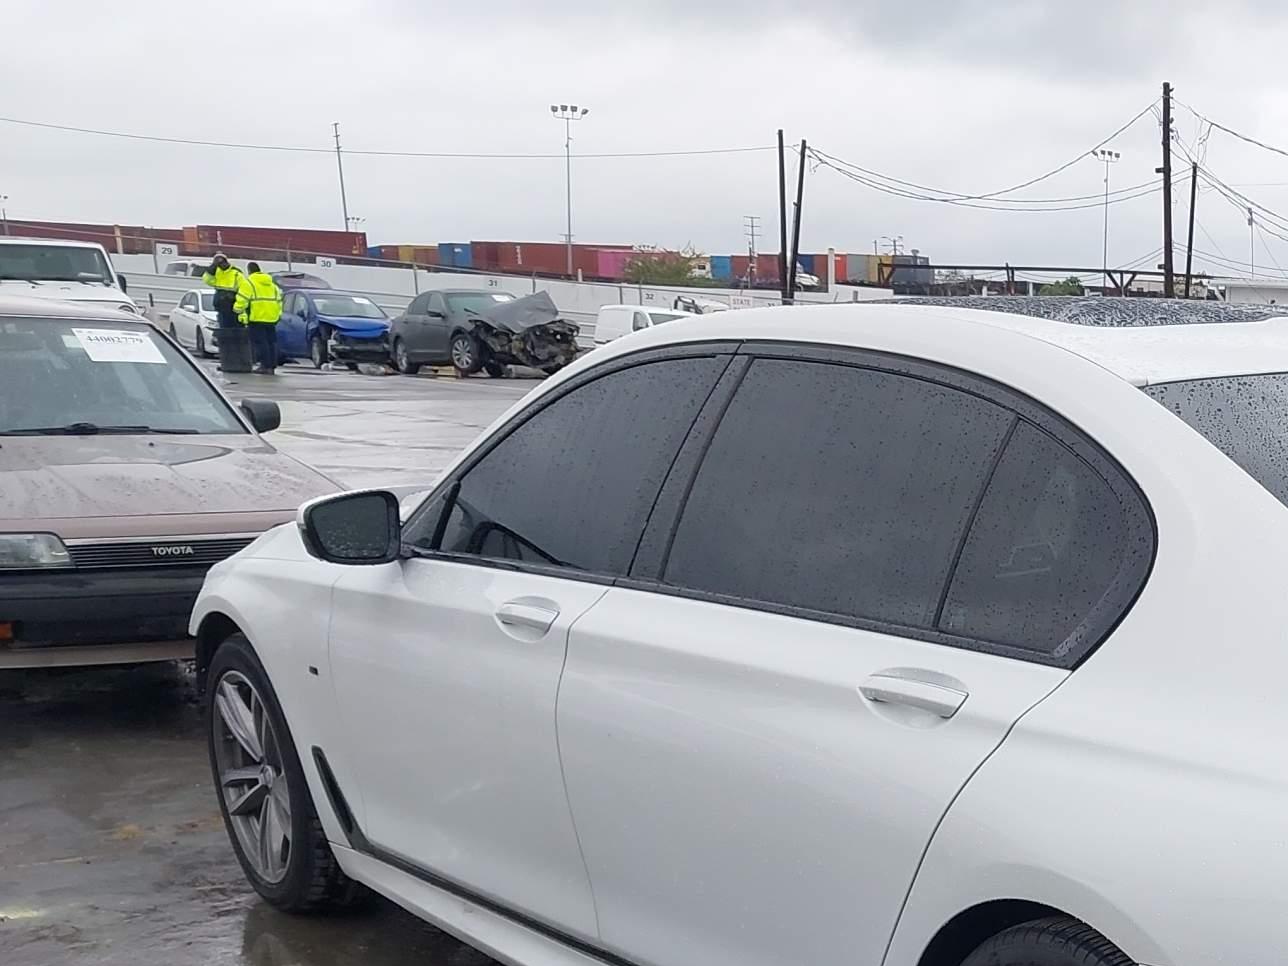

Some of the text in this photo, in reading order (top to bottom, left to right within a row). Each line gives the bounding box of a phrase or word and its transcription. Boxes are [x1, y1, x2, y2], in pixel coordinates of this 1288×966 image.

[161, 247, 173, 255] 29
[320, 259, 332, 268] 30
[488, 279, 498, 287] 31
[151, 546, 194, 556] TOYOTA
